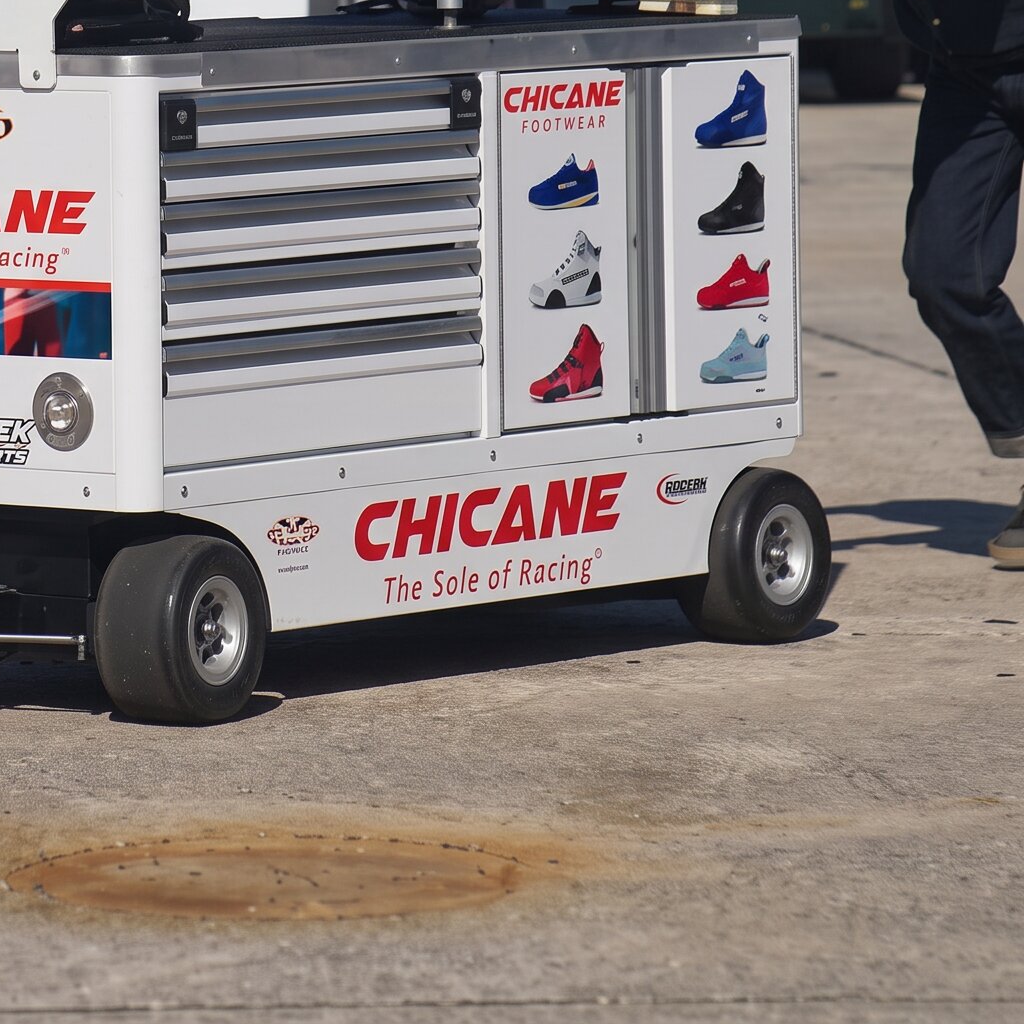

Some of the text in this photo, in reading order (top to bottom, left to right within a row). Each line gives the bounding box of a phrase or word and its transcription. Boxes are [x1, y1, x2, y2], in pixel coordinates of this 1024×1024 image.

[504, 79, 624, 113] CHICANE
[522, 115, 606, 134] FOOTWEAR
[354, 471, 628, 562] CHICANE
[383, 575, 422, 604] The
[433, 569, 479, 598] Sole
[488, 559, 513, 591] of
